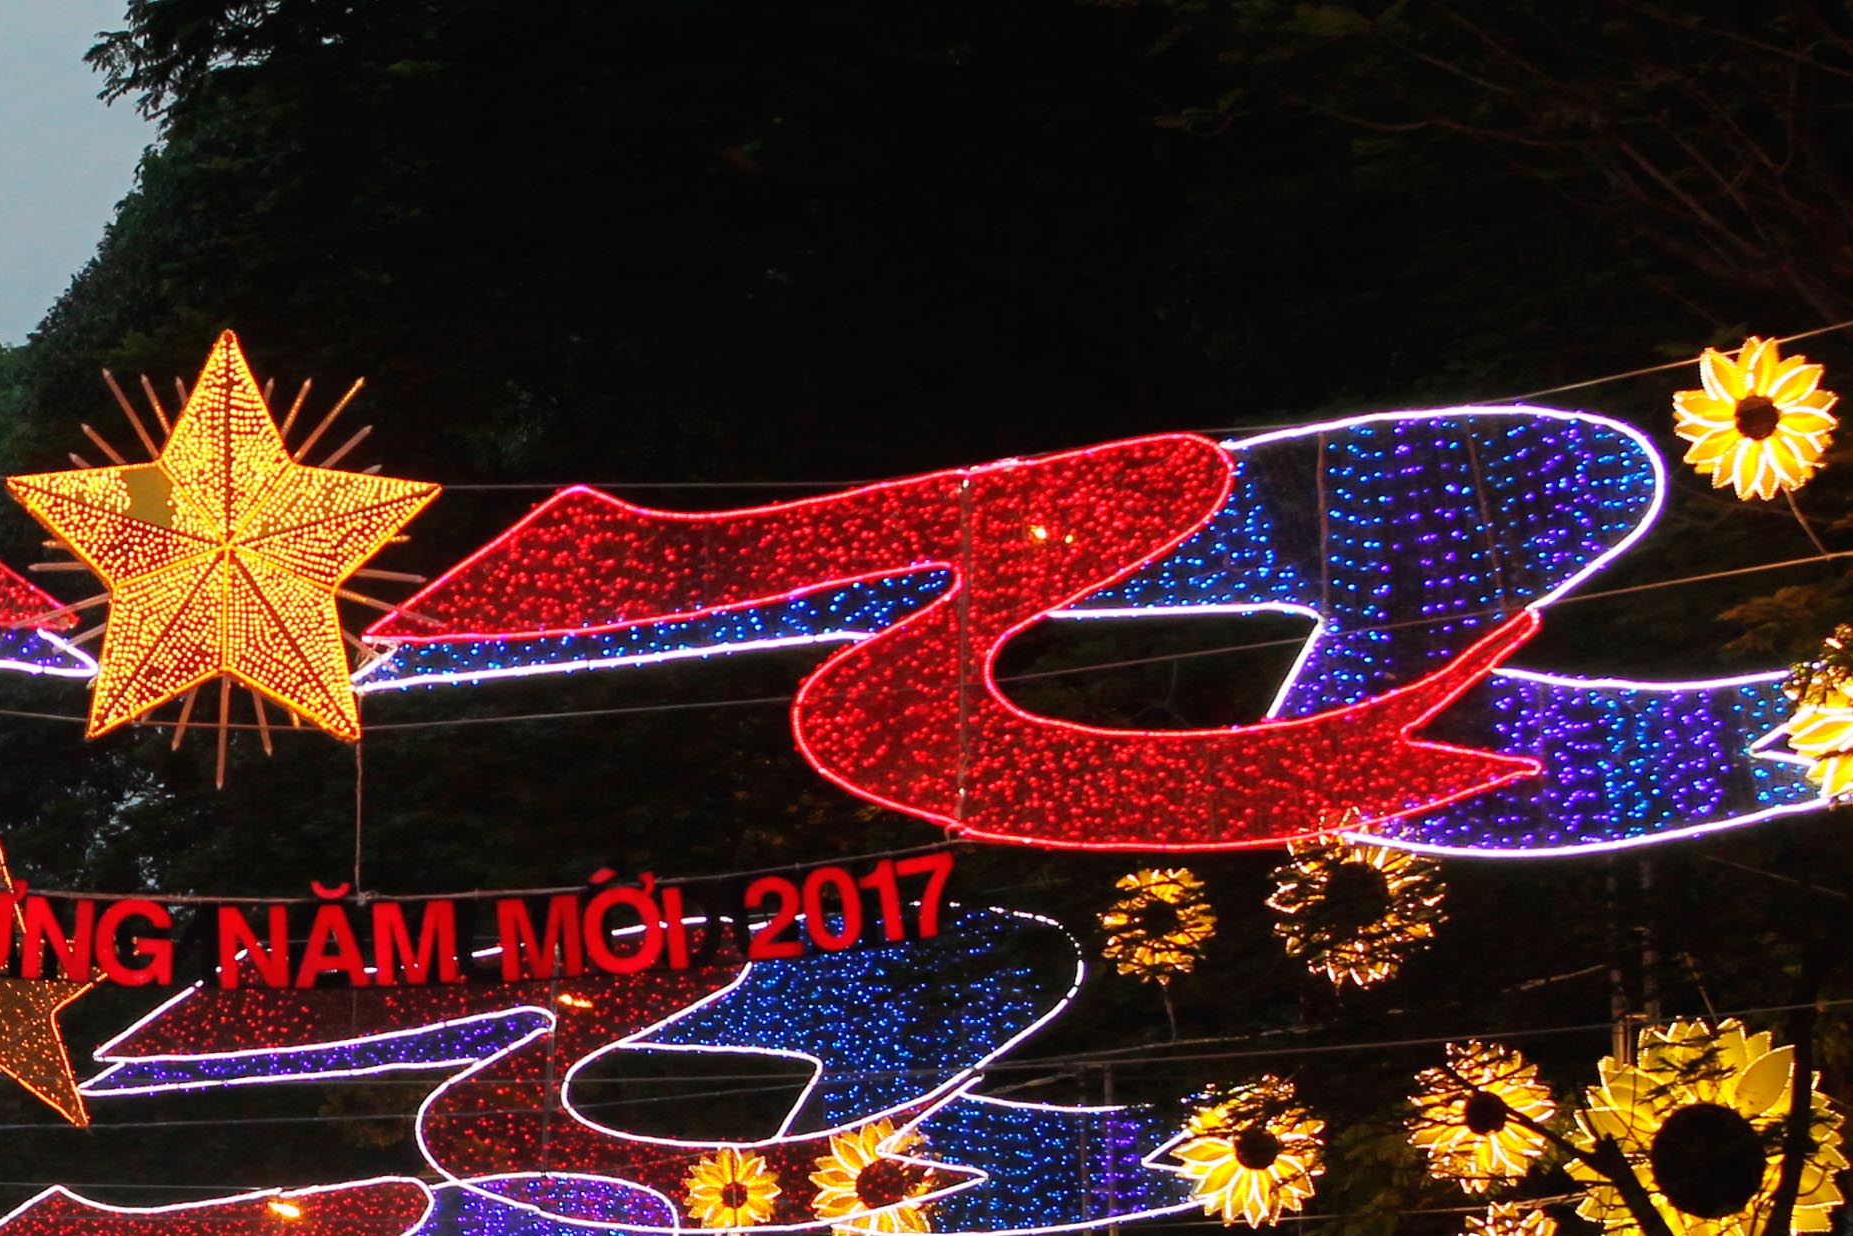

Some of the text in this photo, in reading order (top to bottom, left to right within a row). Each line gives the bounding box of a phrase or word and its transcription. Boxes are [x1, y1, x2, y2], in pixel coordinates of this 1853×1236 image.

[217, 880, 458, 989] NĂM
[496, 866, 690, 982] MỚI
[744, 851, 955, 961] 2017
